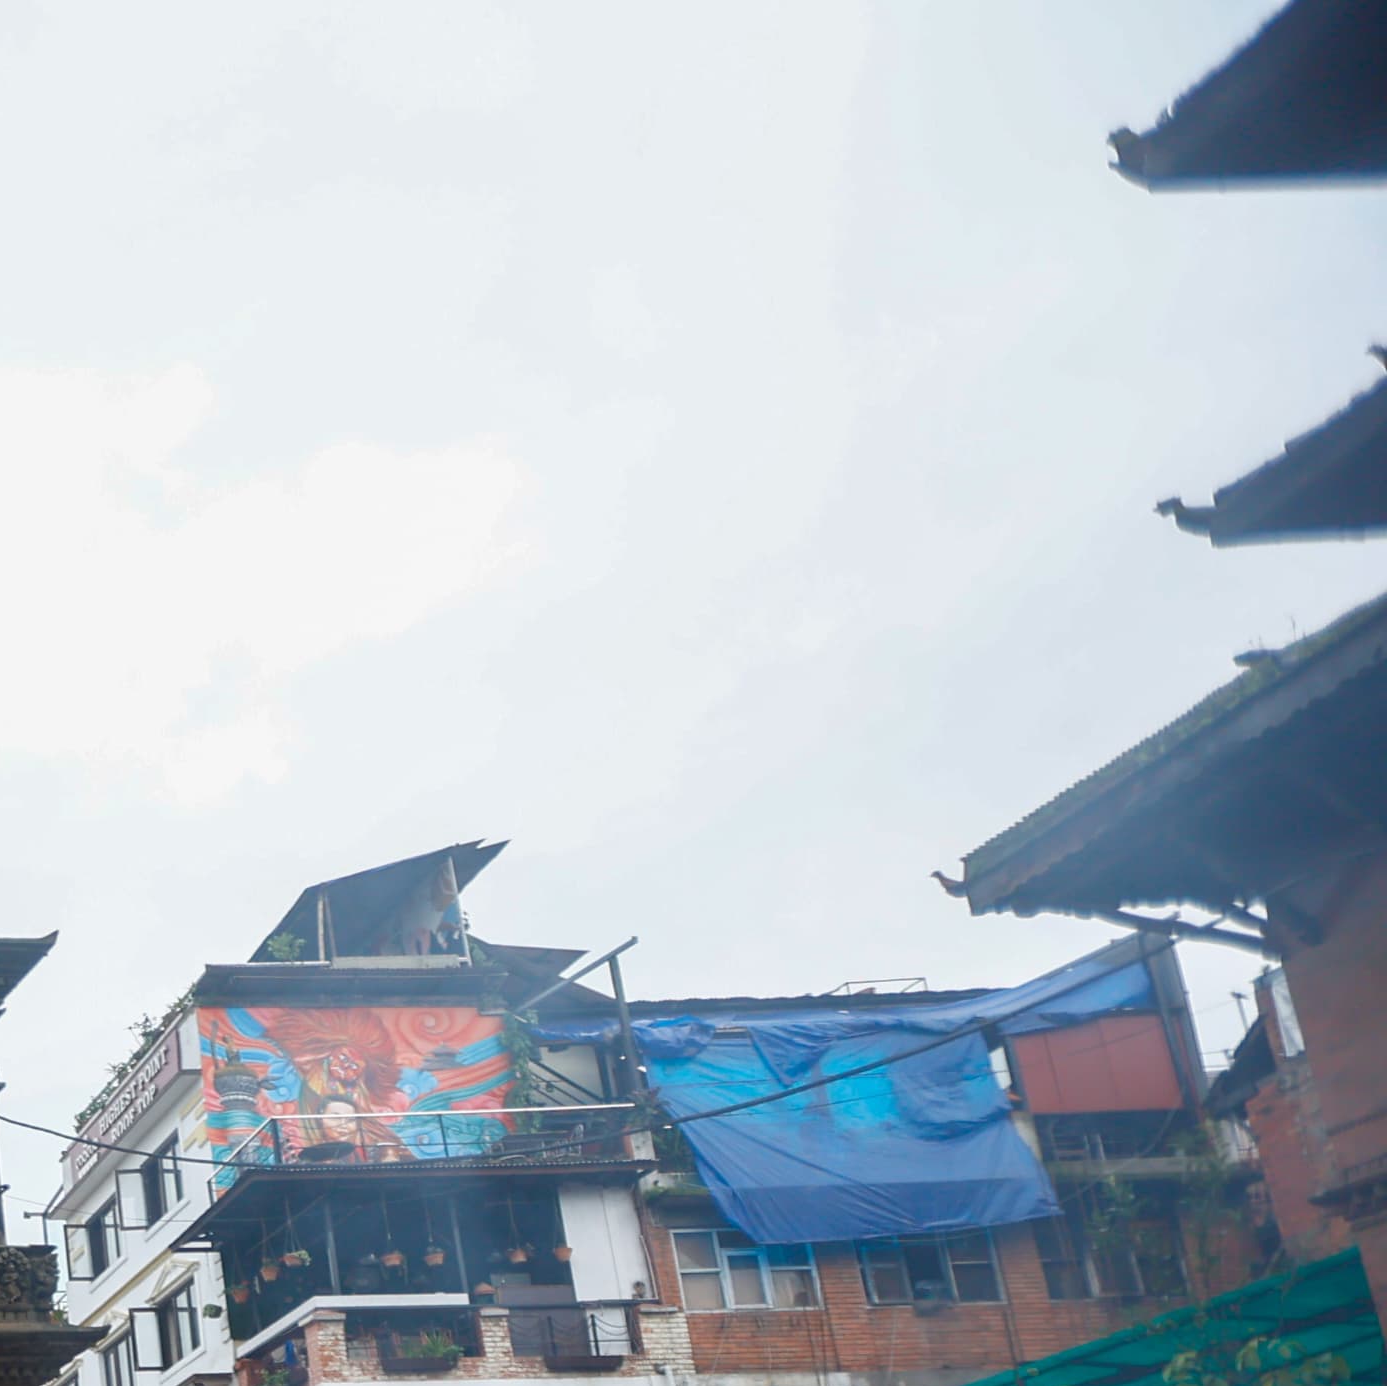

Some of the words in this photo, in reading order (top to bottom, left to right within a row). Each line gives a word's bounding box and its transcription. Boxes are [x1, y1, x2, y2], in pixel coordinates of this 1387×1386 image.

[99, 1081, 137, 1135] HIGHEST
[138, 1046, 168, 1091] POINT
[111, 1107, 135, 1142] ROOF
[138, 1084, 157, 1114] TOP
